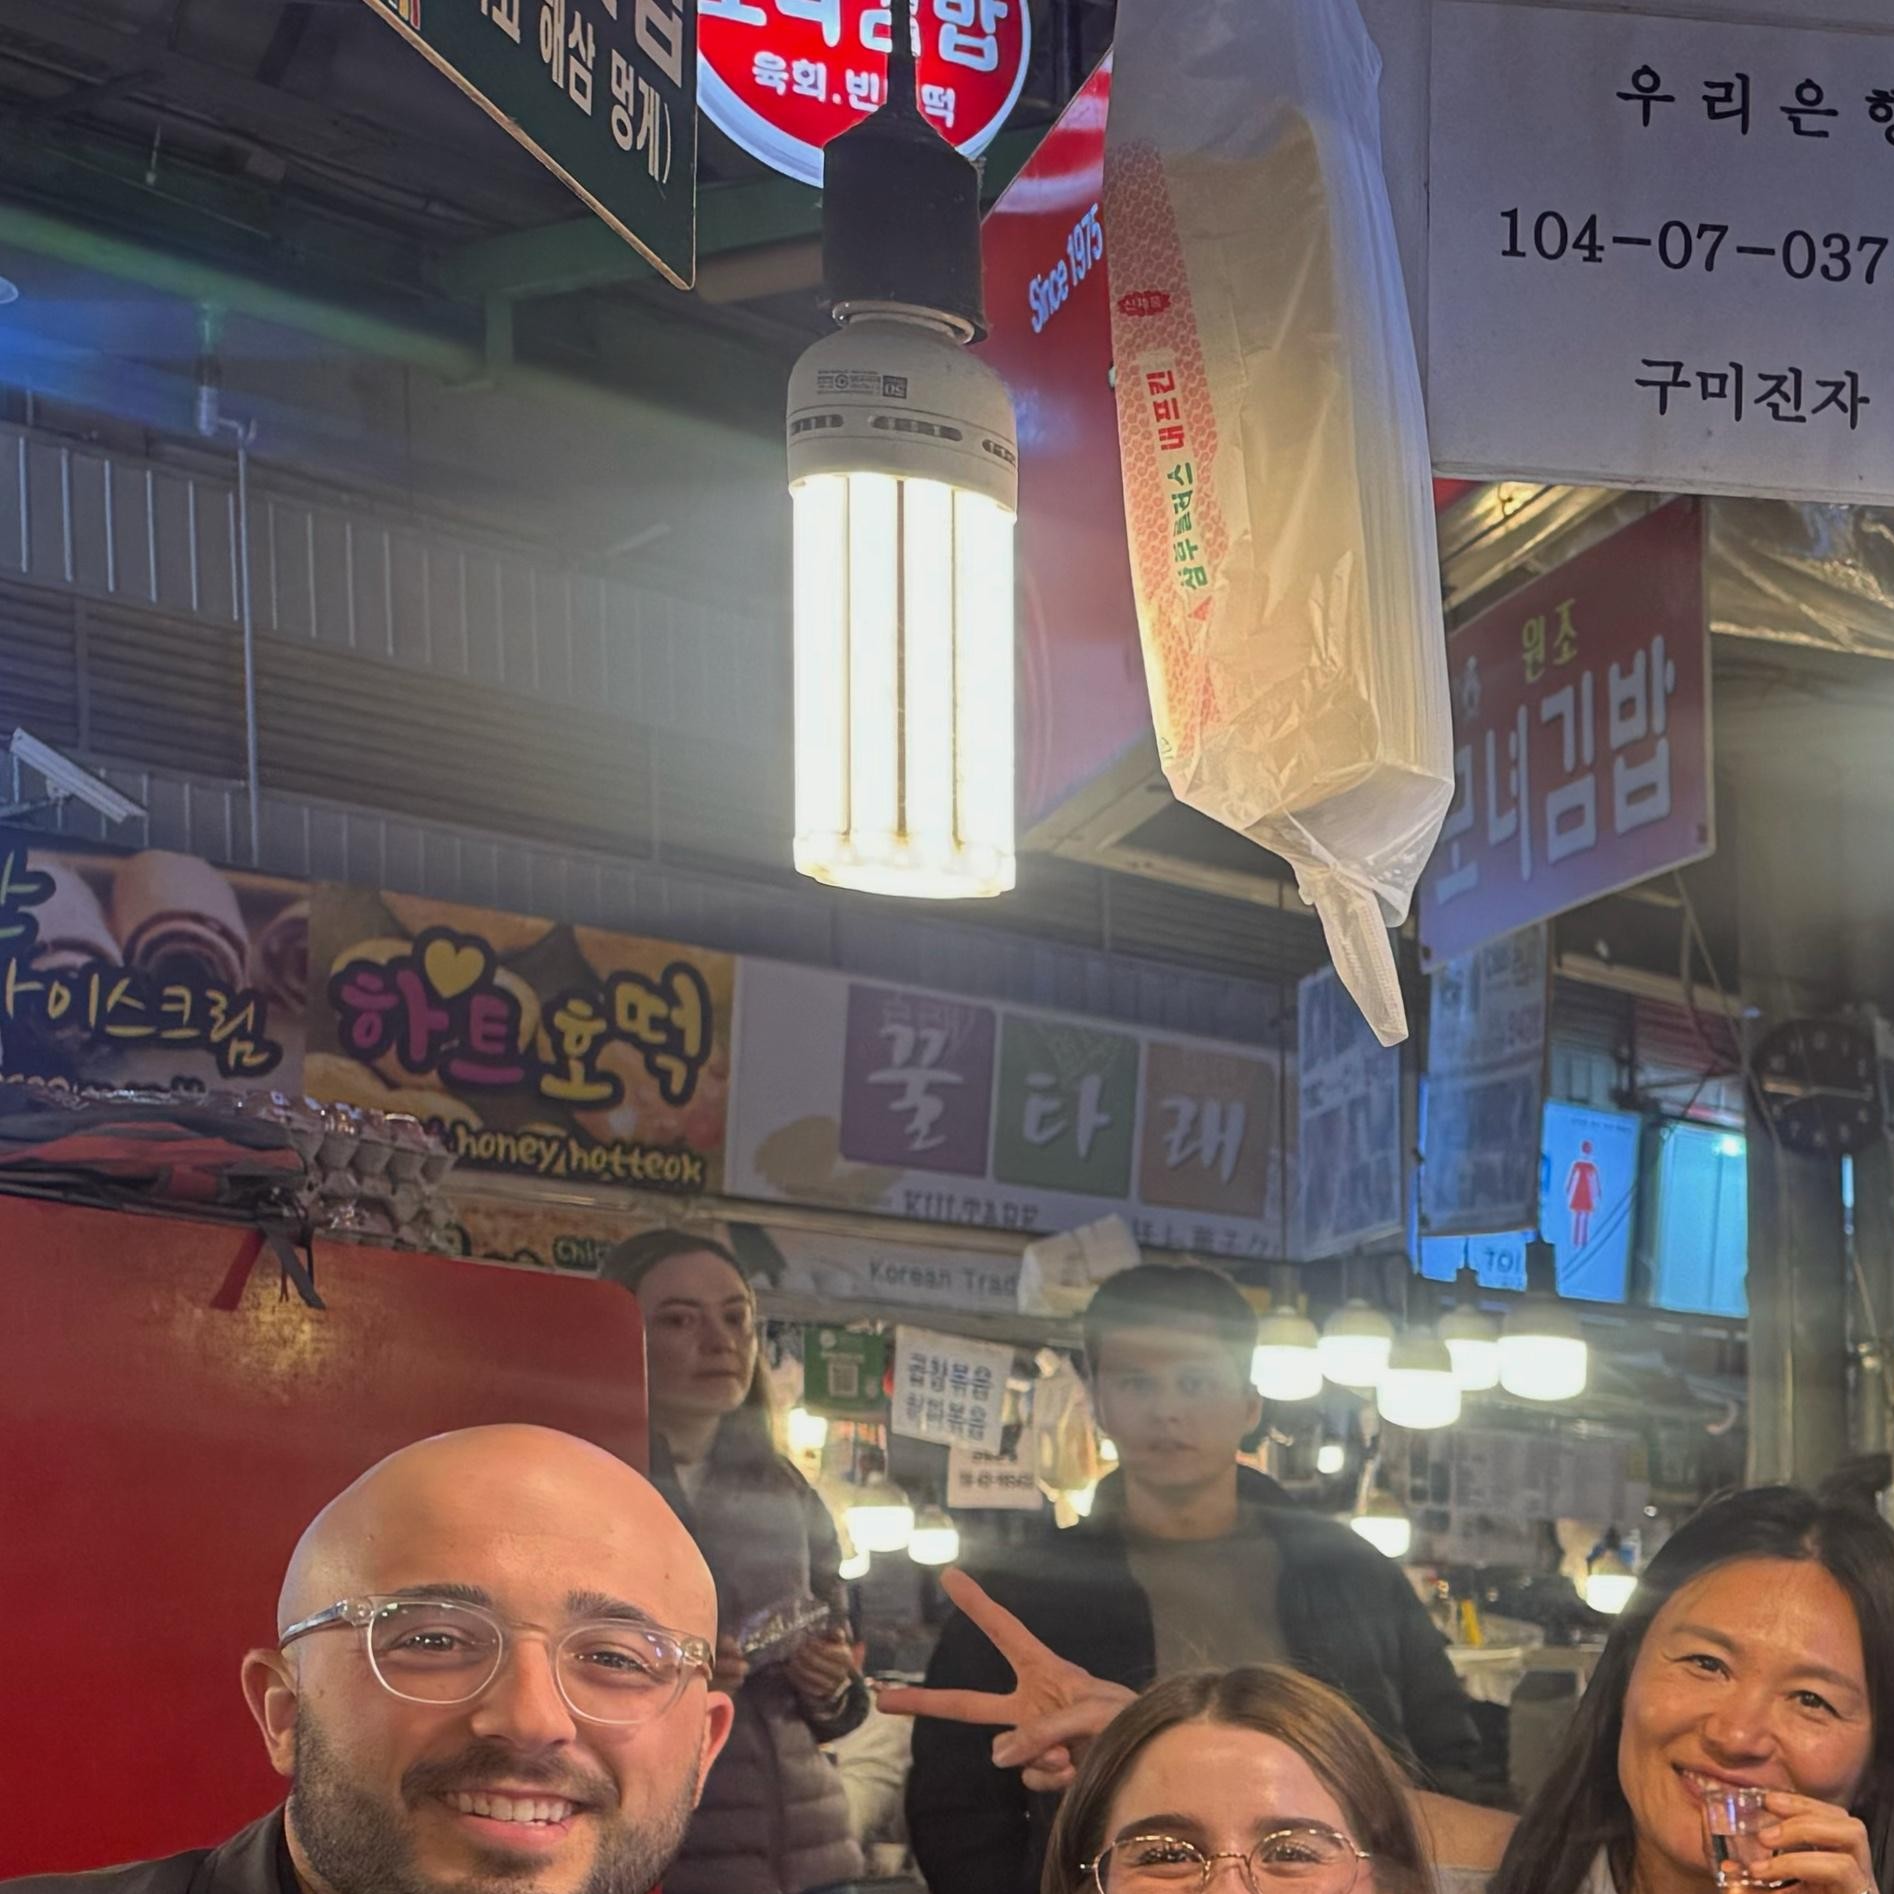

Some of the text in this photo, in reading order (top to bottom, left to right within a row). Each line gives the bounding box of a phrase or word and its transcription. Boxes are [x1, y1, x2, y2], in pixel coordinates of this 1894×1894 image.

[1028, 203, 1104, 334] Since 1975
[1146, 370, 1185, 452] 내프킨
[1635, 358, 1870, 430] 구미진자
[1522, 598, 1577, 684] 원조
[455, 1124, 702, 1183] honey hotteok
[869, 1260, 952, 1288] Korean
